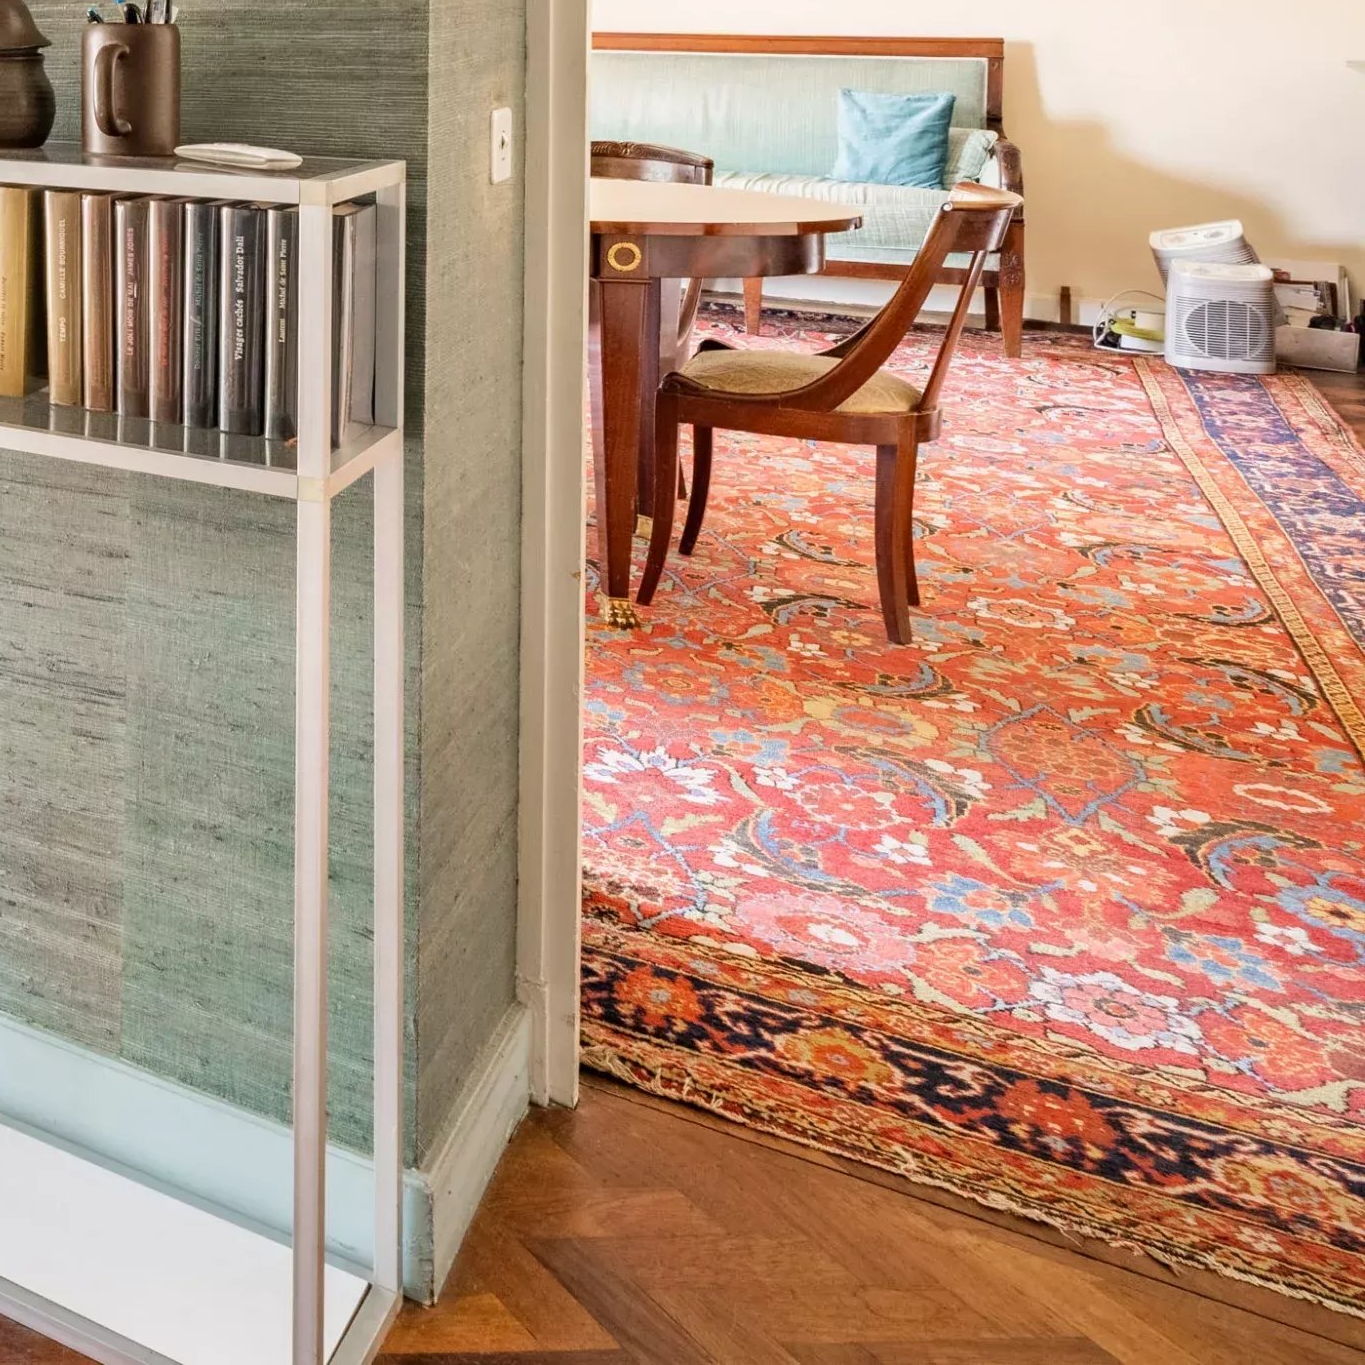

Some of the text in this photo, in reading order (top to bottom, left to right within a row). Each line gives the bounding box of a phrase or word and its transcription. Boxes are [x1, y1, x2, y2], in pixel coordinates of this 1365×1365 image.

[236, 255, 245, 293] Salvador
[127, 297, 134, 307] DE
[279, 286, 287, 309] Michel
[235, 299, 244, 327] cachés
[235, 329, 245, 361] Visages
